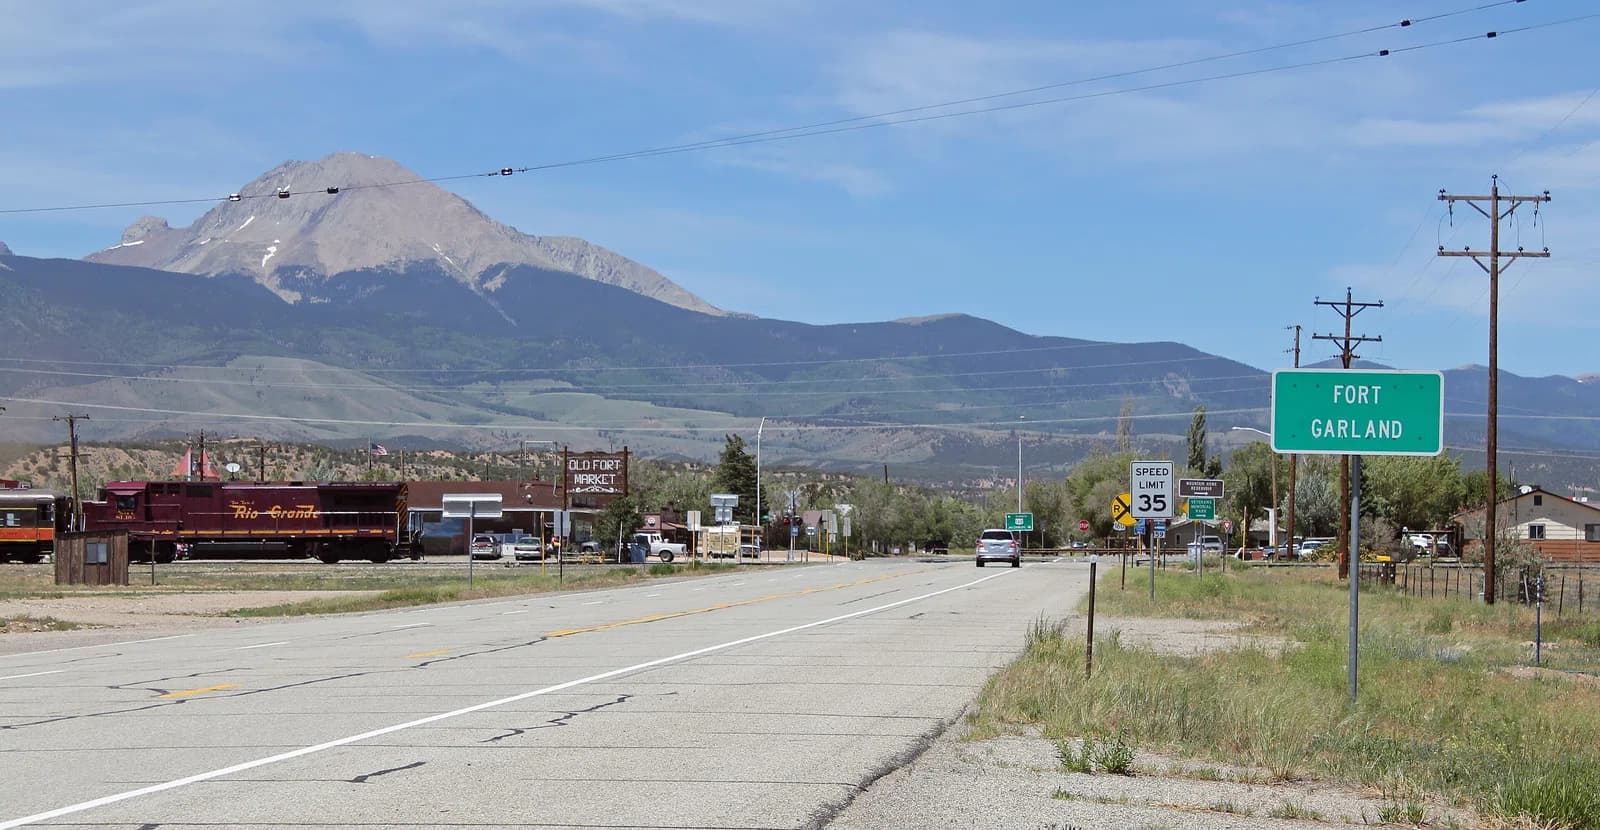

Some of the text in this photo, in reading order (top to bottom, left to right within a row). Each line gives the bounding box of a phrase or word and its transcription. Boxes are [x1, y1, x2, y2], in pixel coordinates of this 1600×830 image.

[1333, 385, 1381, 404] FORT
[1311, 418, 1403, 439] GARLAND
[569, 459, 621, 471] OLD FORT
[1135, 467, 1169, 476] SPEED
[574, 474, 616, 485] MARKET
[1139, 481, 1165, 489] LIMIT
[1113, 504, 1121, 513] R
[1138, 494, 1167, 512] 35
[229, 504, 319, 519] Rio Grande
